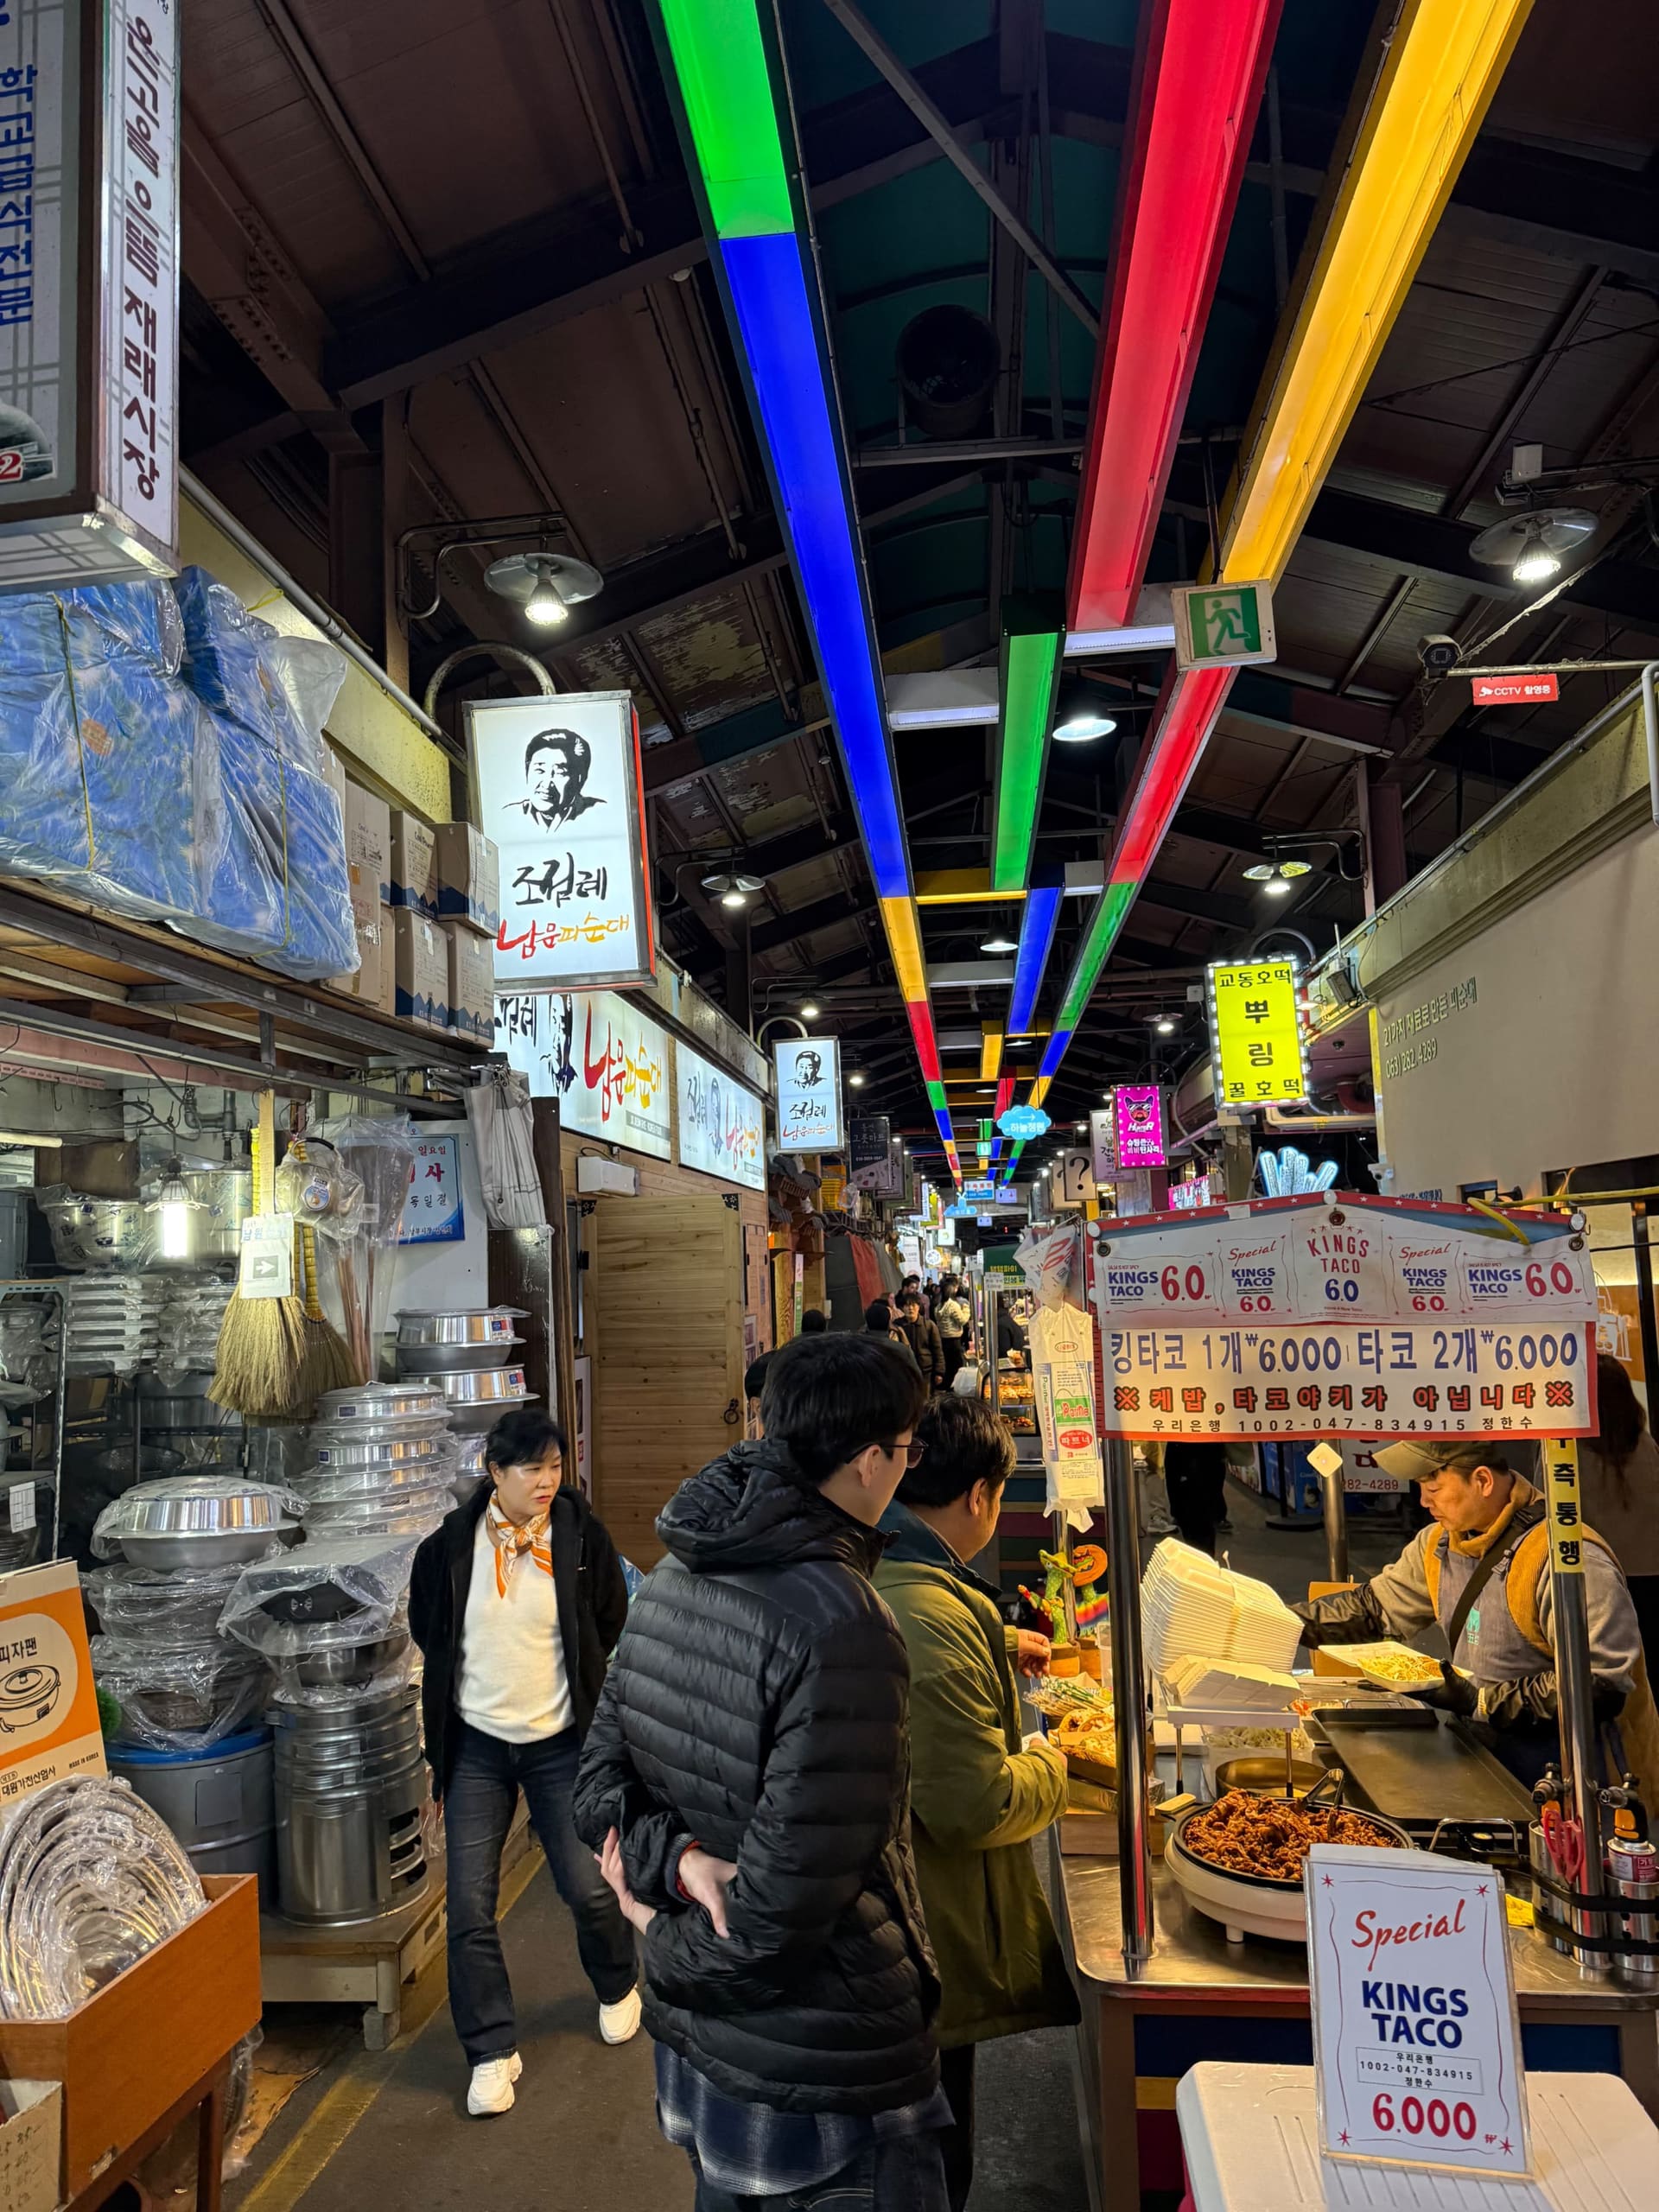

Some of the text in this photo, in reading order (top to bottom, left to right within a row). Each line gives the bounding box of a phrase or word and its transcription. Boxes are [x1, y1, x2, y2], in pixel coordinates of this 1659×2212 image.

[124, 285, 160, 500] 재래시장
[1494, 687, 1522, 696] CCTV
[496, 912, 630, 960] 남문피순대
[1228, 1240, 1276, 1267] Special
[1307, 1234, 1370, 1257] KINGS
[1399, 1243, 1452, 1266] Special
[1231, 1268, 1275, 1278] KINGS
[1320, 1258, 1360, 1274] TACO
[1402, 1268, 1447, 1278] KINGS
[1468, 1269, 1522, 1281] KINGS
[1108, 1271, 1159, 1284] KINGS
[1160, 1265, 1205, 1301] 6.0
[1235, 1277, 1273, 1287] TACO
[1407, 1277, 1445, 1287] TACO
[1470, 1283, 1508, 1294] TACO
[1525, 1262, 1573, 1297] 6.0
[1109, 1286, 1144, 1296] TACO
[1325, 1279, 1359, 1302] 6.0
[1110, 1332, 1186, 1374] 킹타코
[1202, 1332, 1243, 1374] 1개
[1357, 1329, 1417, 1374] 타코
[1433, 1328, 1478, 1374] 2개
[1153, 1420, 1220, 1433] 우리은행
[1482, 1417, 1534, 1431] 정한수
[0, 1637, 38, 1664] 피자팬
[1351, 1899, 1467, 1972] Special
[1361, 1980, 1469, 2018] KINGS
[1371, 2013, 1462, 2049] TACO
[1396, 2052, 1434, 2065] 우리은행
[1359, 2060, 1473, 2081] 1002-047-834915
[1404, 2075, 1433, 2089] 정한수
[1372, 2093, 1477, 2140] 6.000
